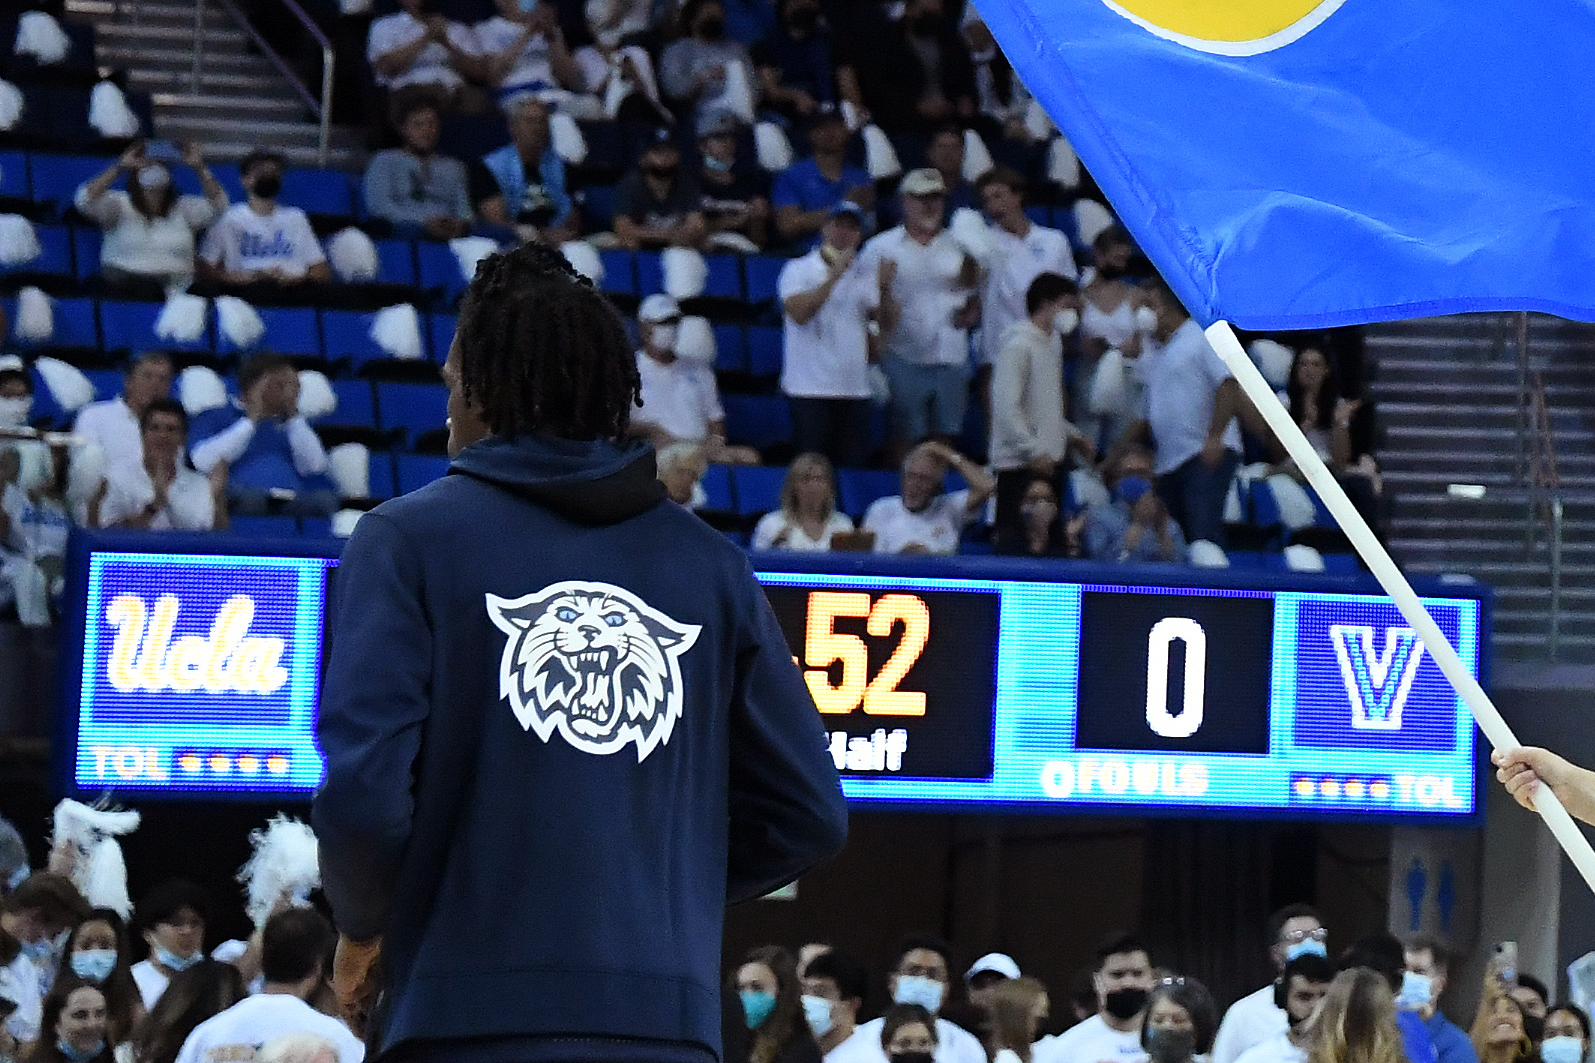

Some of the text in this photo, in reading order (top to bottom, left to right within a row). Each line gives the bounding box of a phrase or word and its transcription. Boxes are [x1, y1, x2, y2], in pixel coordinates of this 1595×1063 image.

[106, 592, 288, 694] Ucla
[1146, 617, 1206, 737] 0
[92, 746, 168, 781] TOL
[1078, 760, 1208, 796] FOULS
[1400, 775, 1462, 807] TOL
